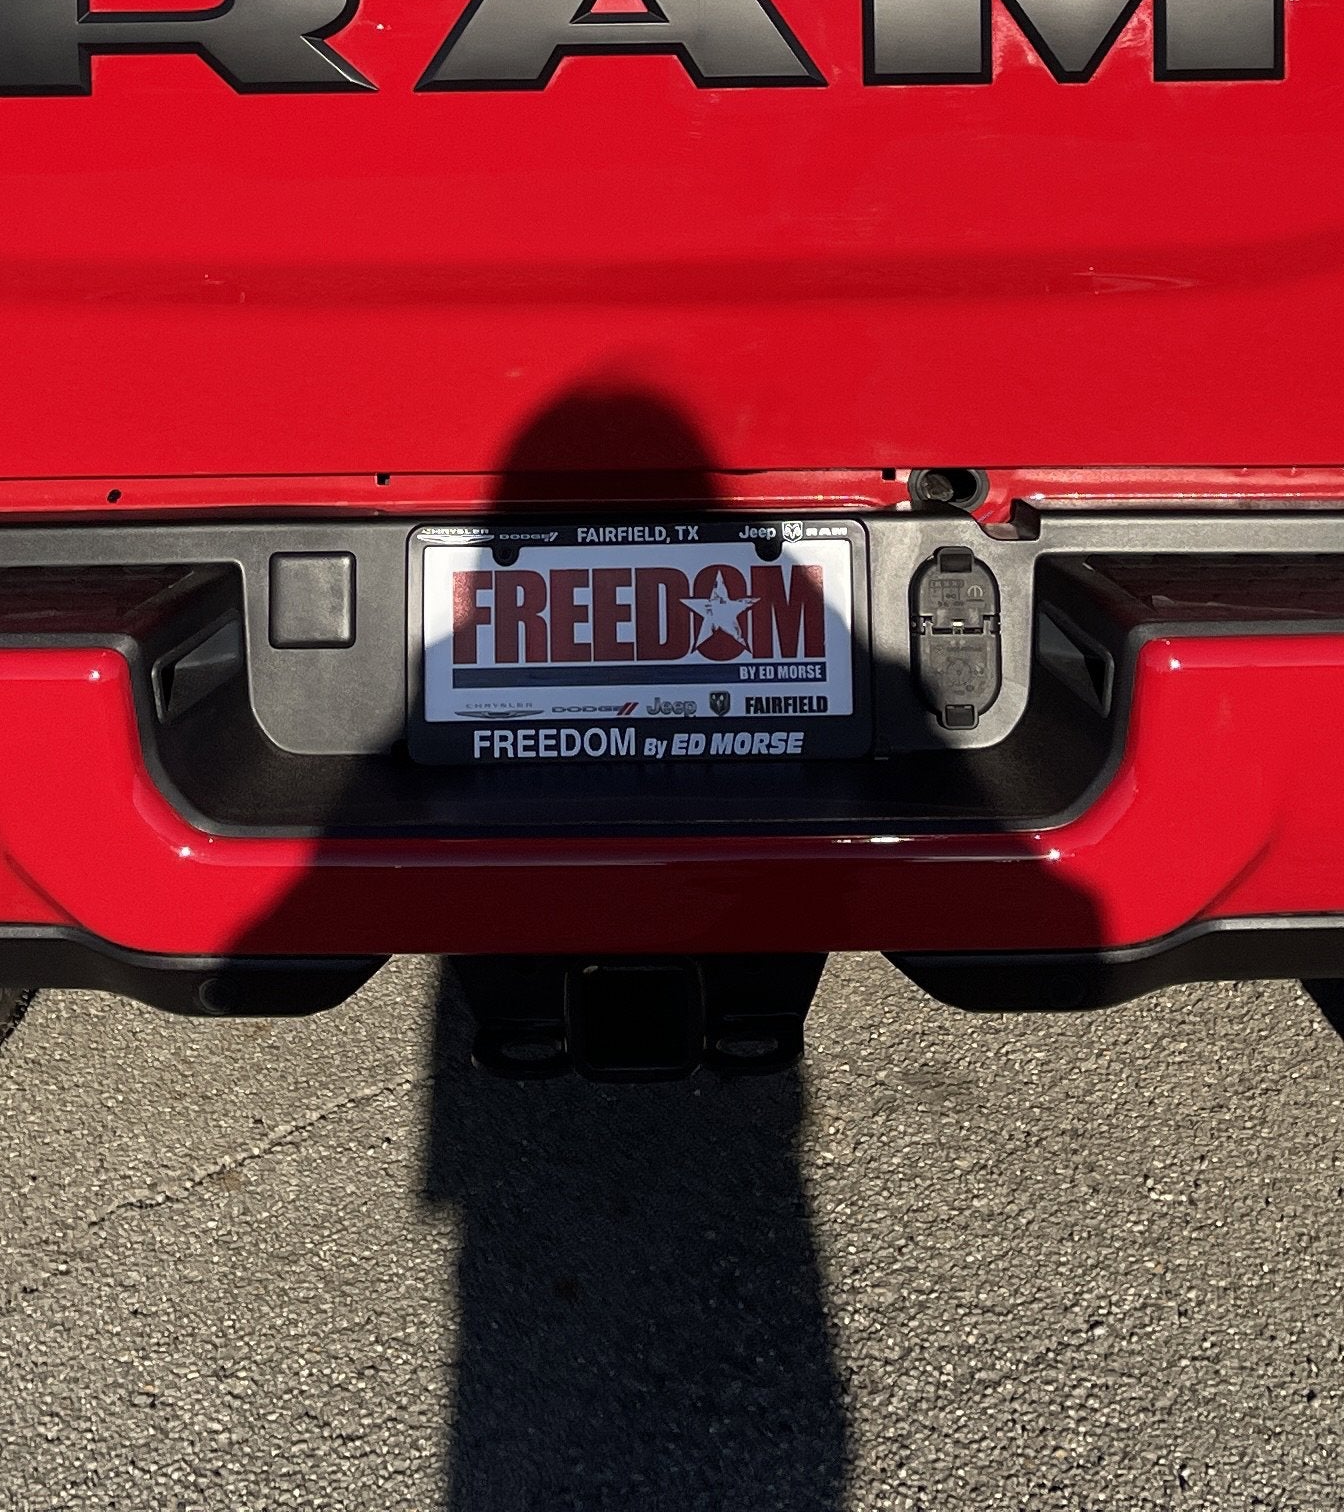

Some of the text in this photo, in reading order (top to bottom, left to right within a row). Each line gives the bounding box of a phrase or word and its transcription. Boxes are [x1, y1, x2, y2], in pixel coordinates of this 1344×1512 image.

[576, 525, 699, 544] FAIRFIELD, TX
[738, 525, 848, 541] Jeep RAM
[452, 563, 826, 664] FREEDOM
[739, 664, 823, 680] BY ED MORSE
[551, 705, 620, 713] DODGE
[646, 696, 698, 716] Jeep
[745, 695, 829, 715] FAIRFIELD
[472, 728, 805, 760] FREEDOM By ED MORSE
